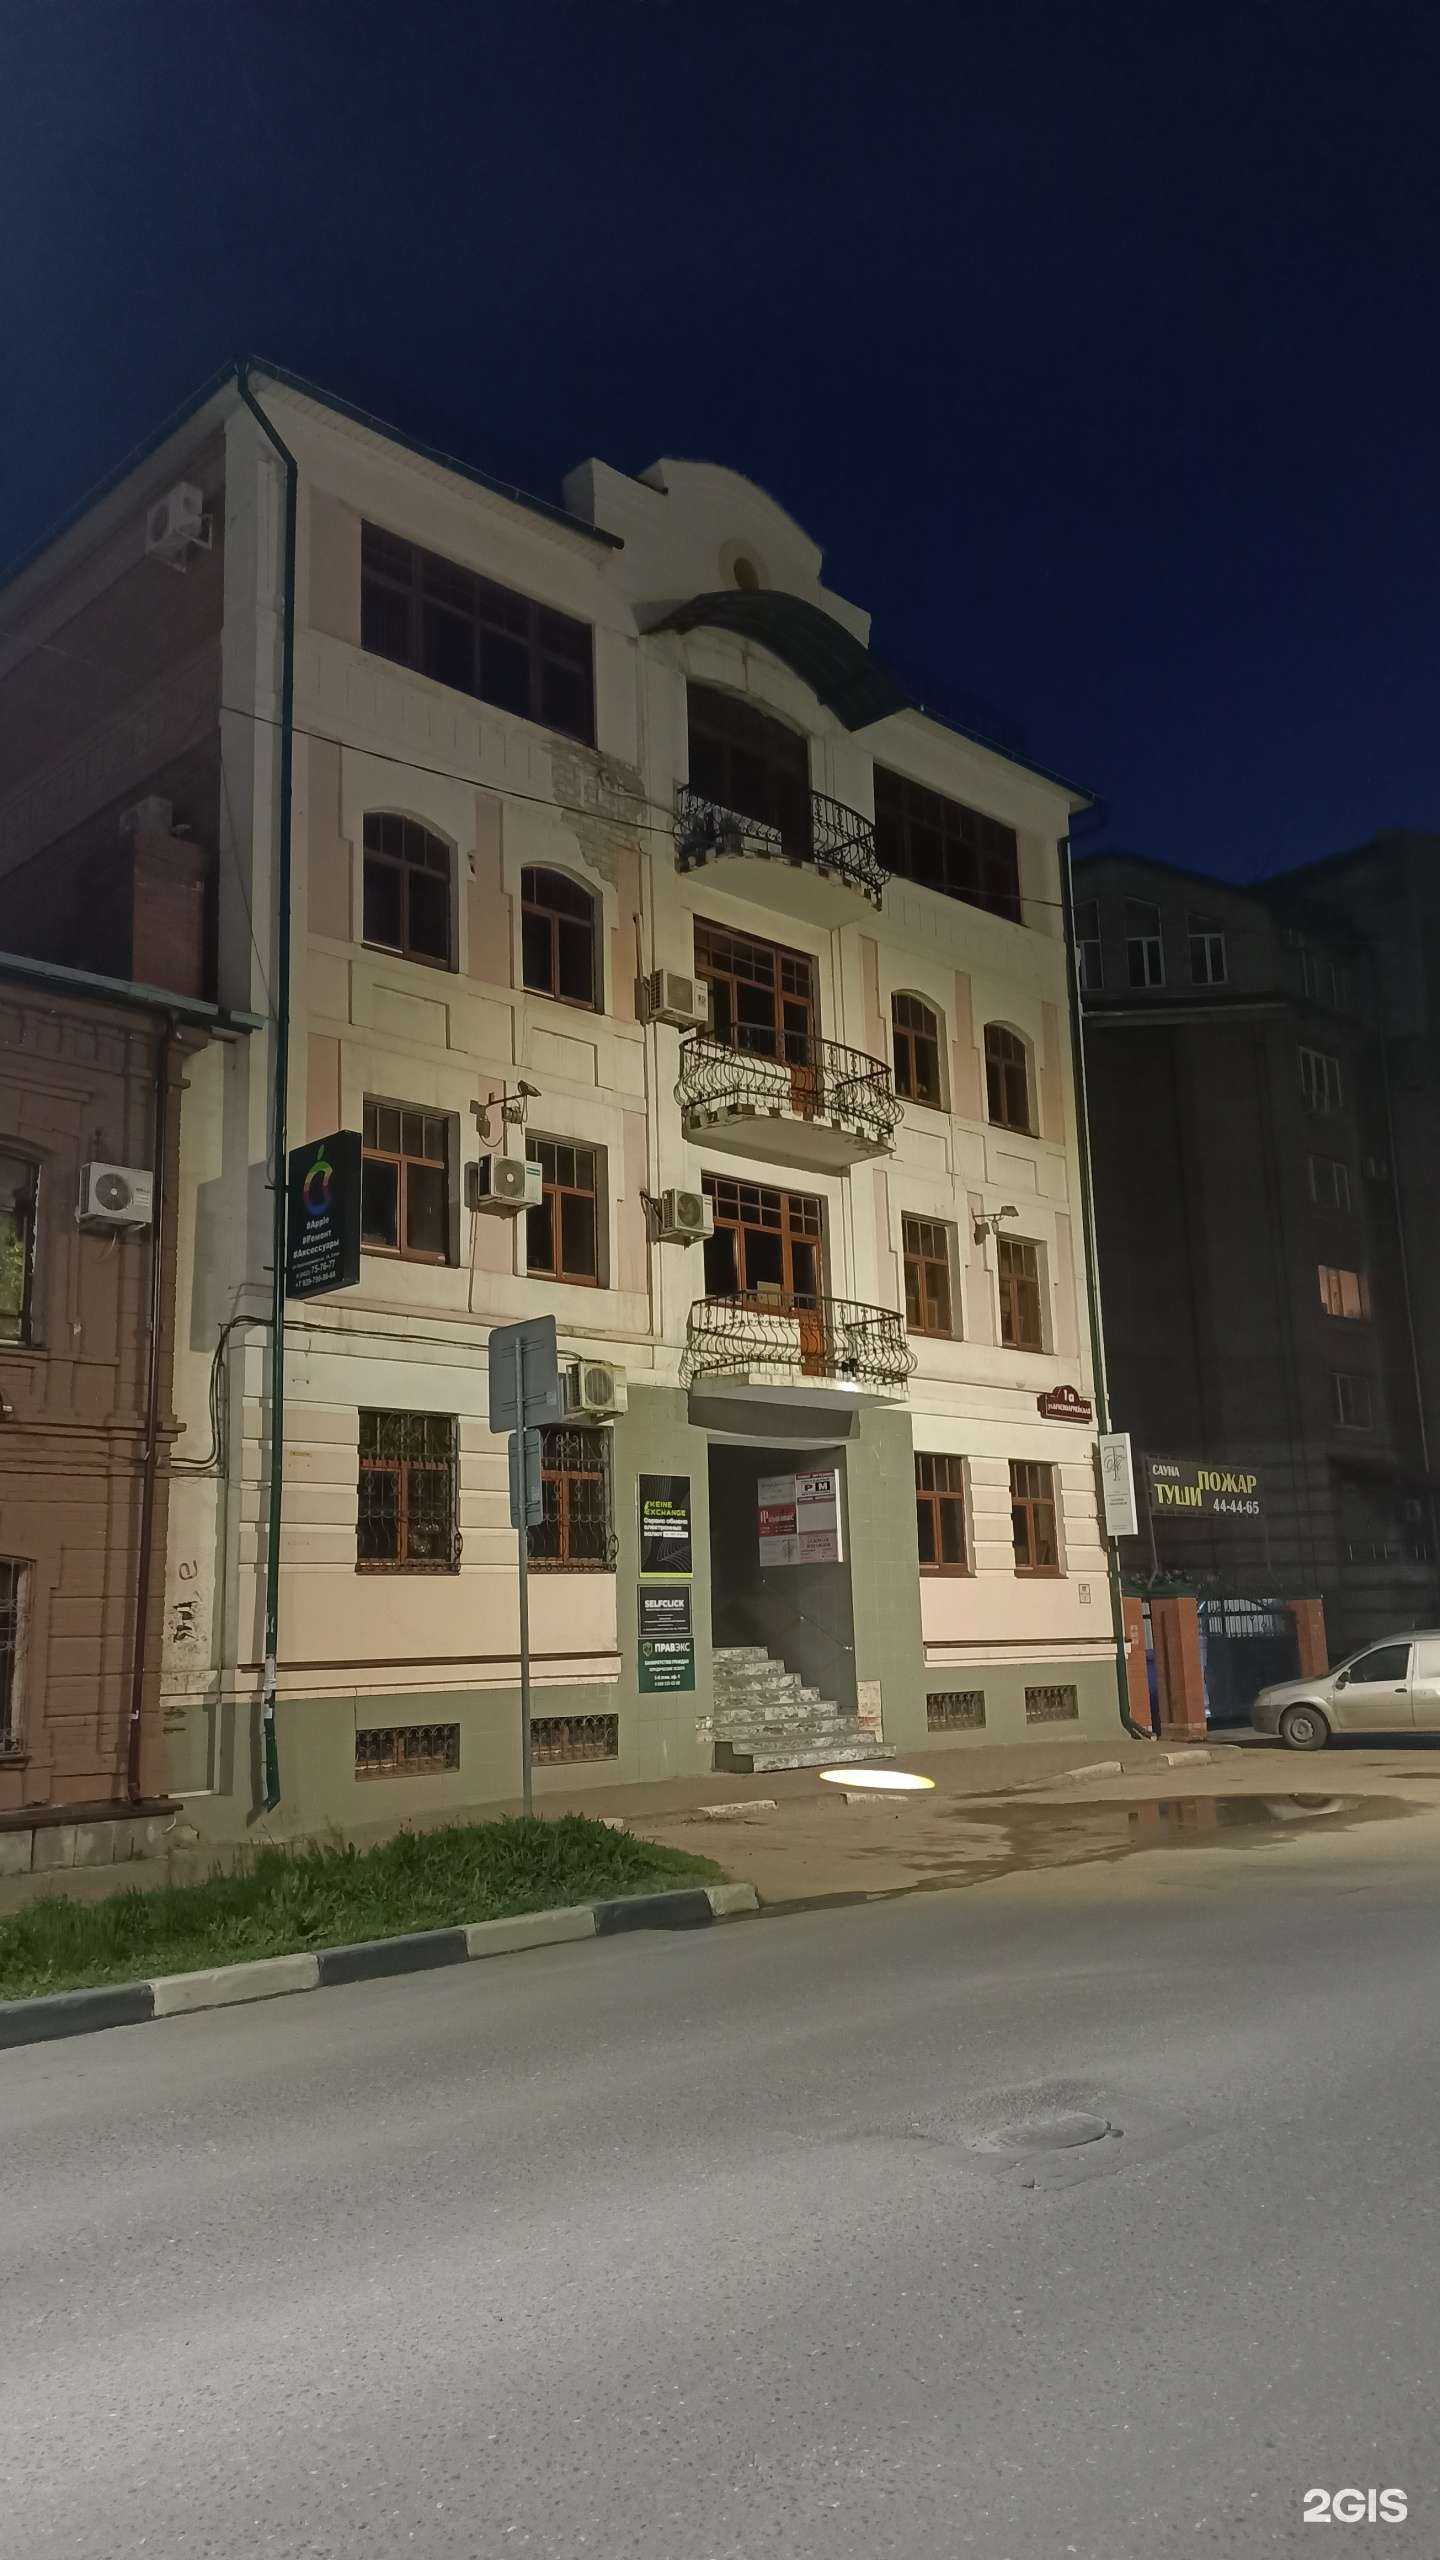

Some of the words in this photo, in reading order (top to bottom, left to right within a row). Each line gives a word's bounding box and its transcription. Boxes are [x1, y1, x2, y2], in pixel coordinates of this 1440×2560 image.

[1152, 1464, 1180, 1477] САУНА
[1197, 1470, 1257, 1494] ПОЖАР
[1154, 1483, 1203, 1507] ТУШИ
[1213, 1498, 1260, 1514] 44-44-65
[644, 1599, 685, 1608] SELFCLICK
[654, 1643, 690, 1652] ПРАВЭКС
